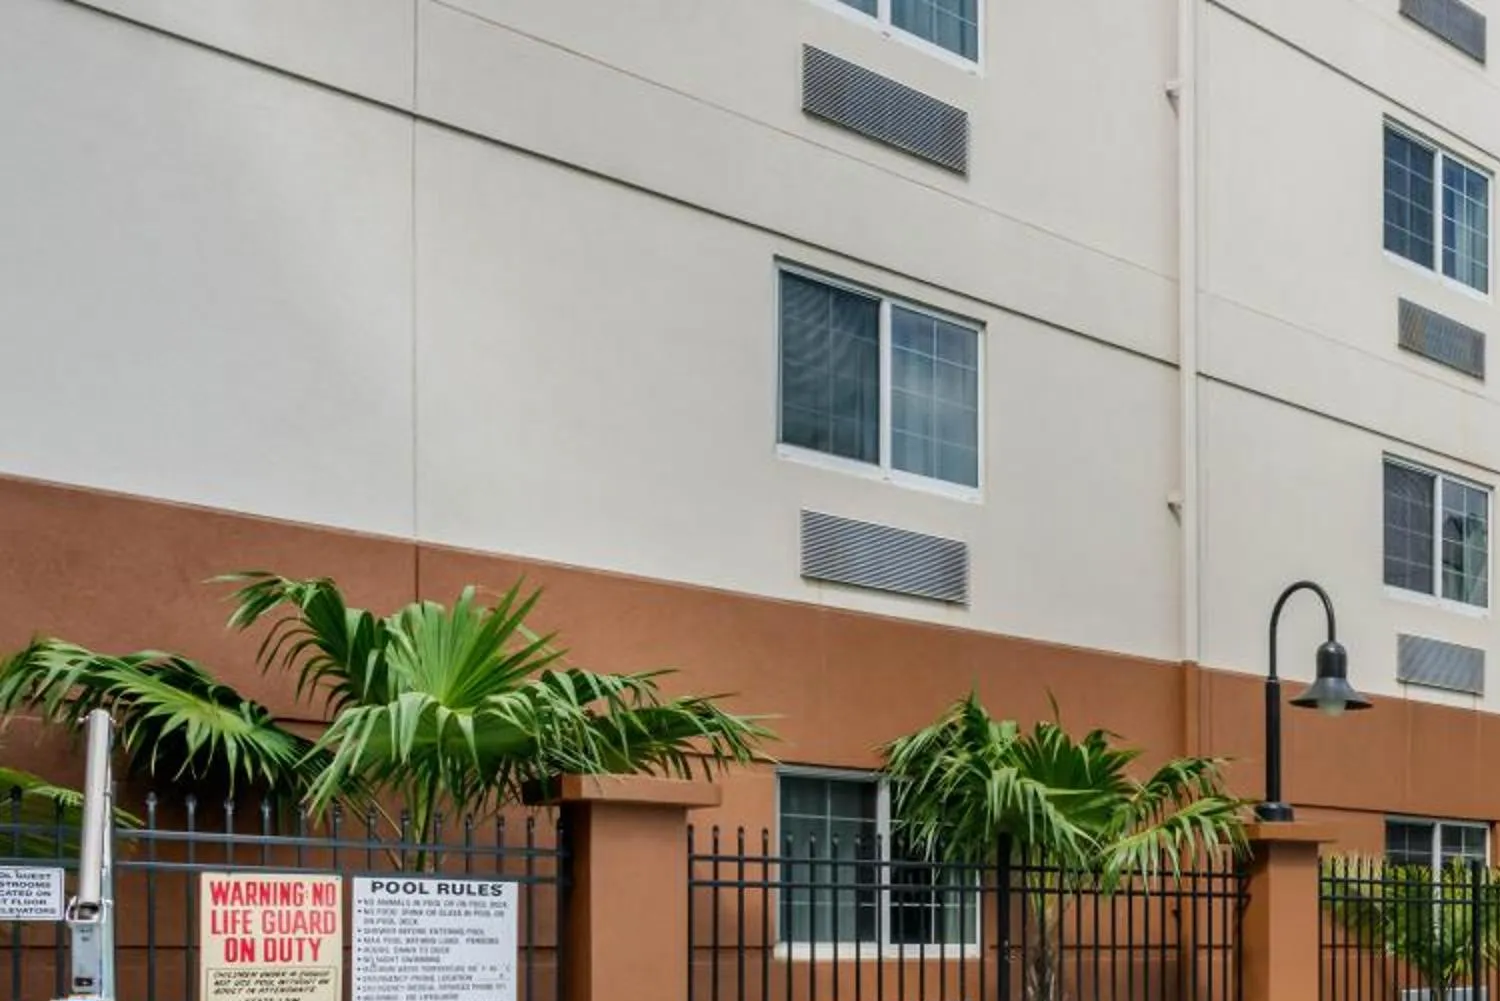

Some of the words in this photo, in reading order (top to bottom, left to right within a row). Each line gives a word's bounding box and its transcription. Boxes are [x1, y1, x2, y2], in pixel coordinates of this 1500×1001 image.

[312, 882, 336, 906] NO
[371, 881, 430, 895] POOL
[437, 882, 503, 897] RULES
[211, 910, 252, 934] LIFE
[262, 910, 336, 934] GUARD
[225, 937, 256, 962] ON
[264, 937, 322, 962] DUTY
